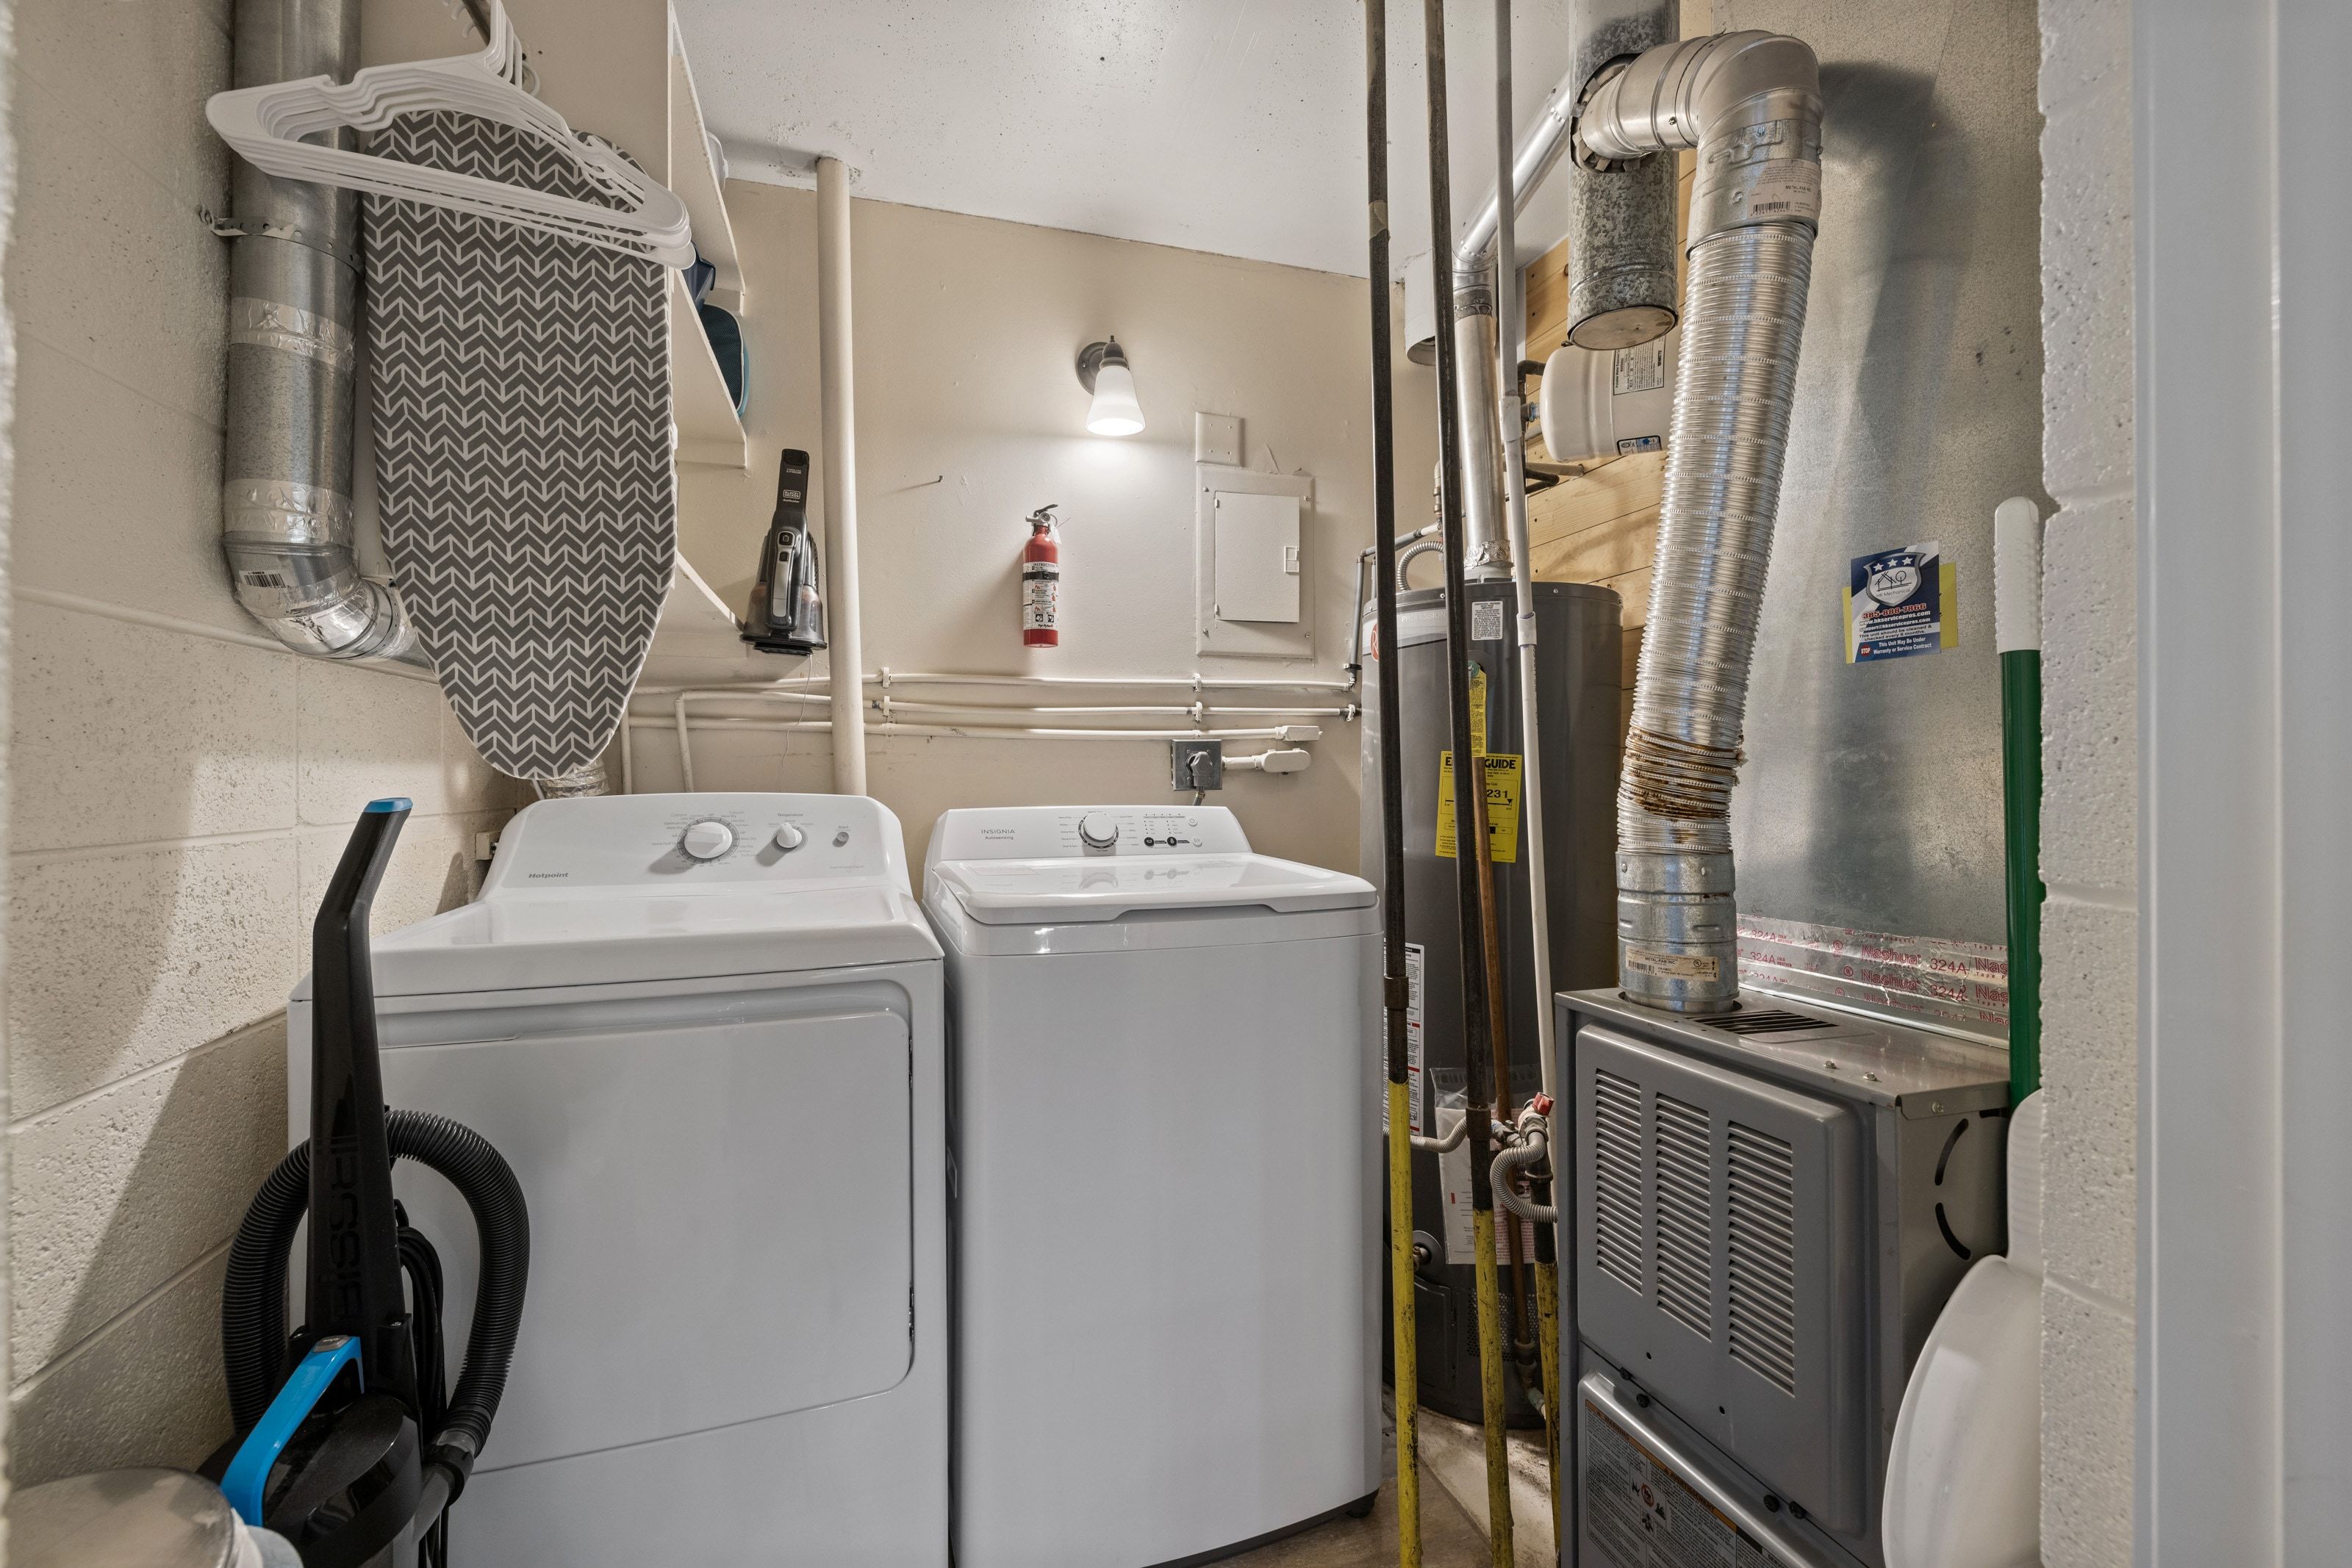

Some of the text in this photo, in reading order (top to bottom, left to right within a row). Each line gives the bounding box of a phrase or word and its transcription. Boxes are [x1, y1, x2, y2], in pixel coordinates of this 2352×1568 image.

[1883, 588, 1911, 596] Mechanical
[1859, 610, 1930, 626] www.hkservicepros.com
[1862, 603, 1926, 619] 385-888-7866
[1645, 957, 1667, 965] METAL-FAB
[1862, 944, 1918, 965] Nashua
[1930, 958, 1967, 975] 324A
[1750, 952, 1776, 965] 324A
[1862, 969, 1917, 990] Nashua
[1605, 1416, 1629, 1441] WARNING
